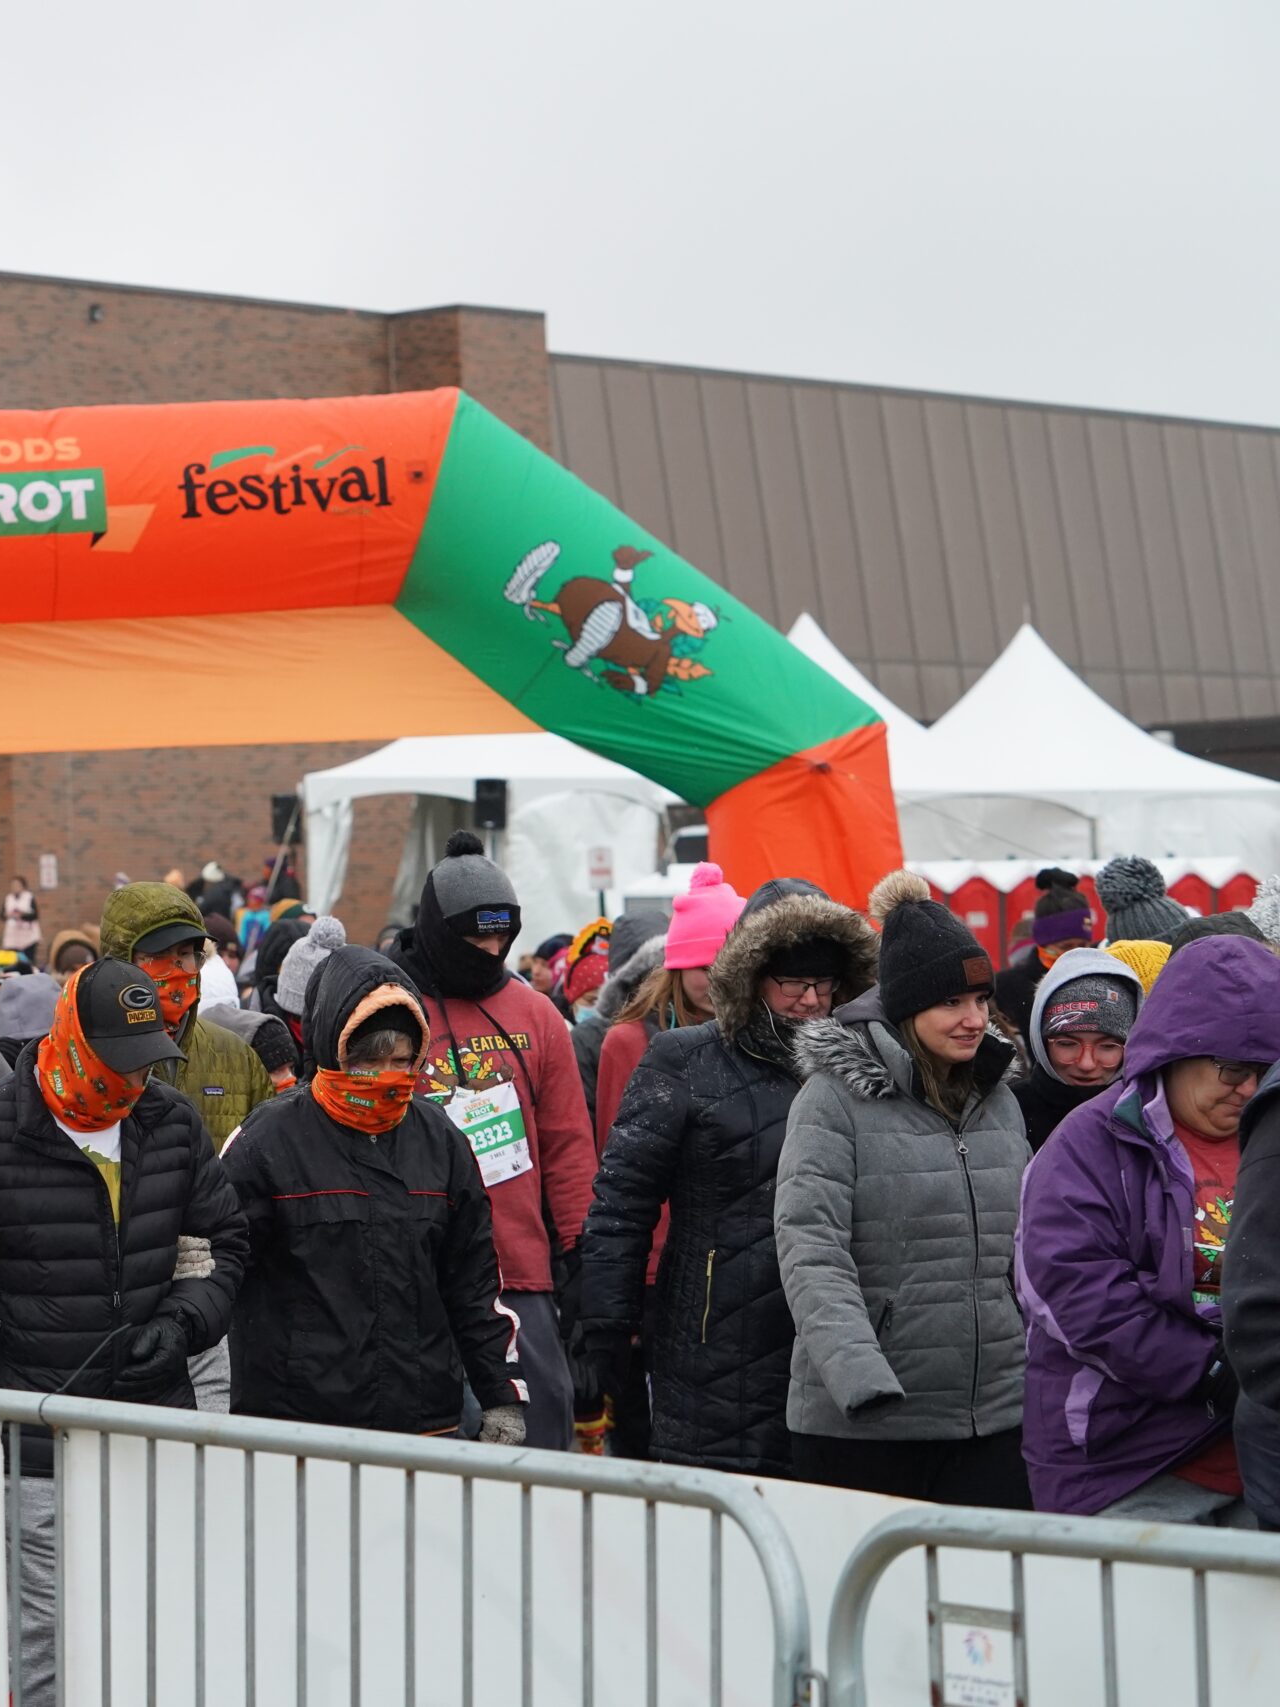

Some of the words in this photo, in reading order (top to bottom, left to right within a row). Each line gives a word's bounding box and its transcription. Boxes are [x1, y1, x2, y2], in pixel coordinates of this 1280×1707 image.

[178, 456, 392, 519] festival
[128, 1010, 155, 1023] PACKERS
[471, 1035, 495, 1052] EAT
[70, 1046, 82, 1072] TROT
[54, 1074, 63, 1092] TROT
[350, 1096, 371, 1106] TROT
[472, 1105, 490, 1118] TROT
[469, 1120, 513, 1149] 23323
